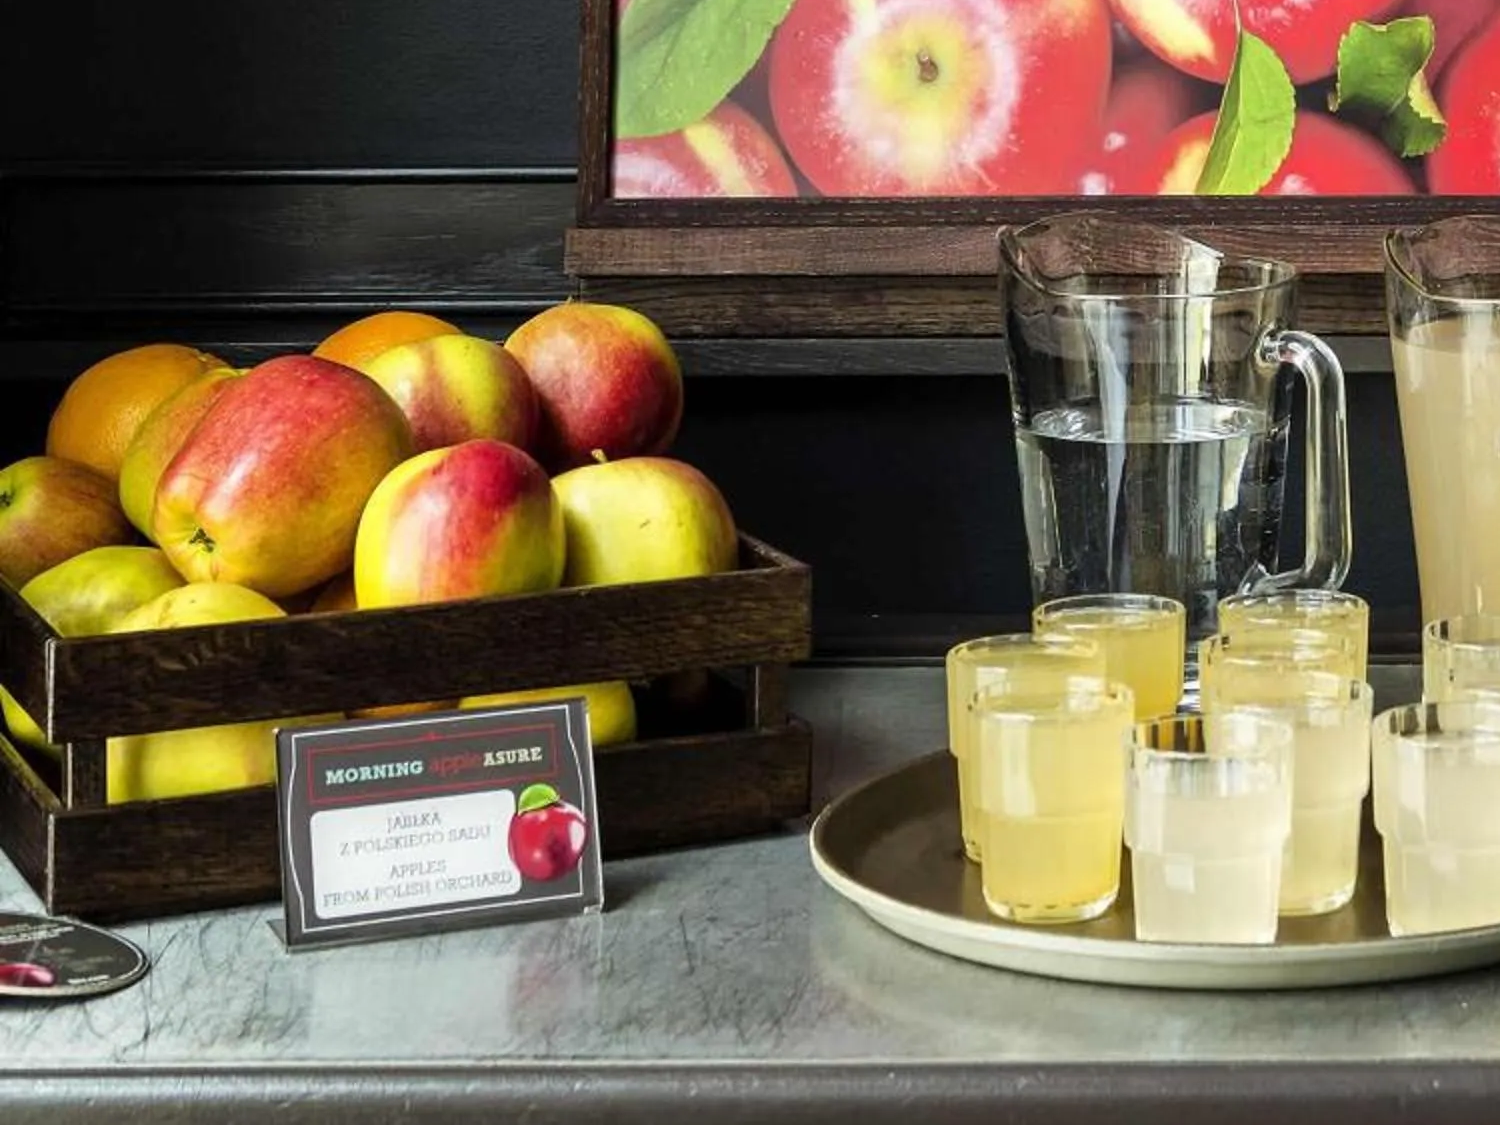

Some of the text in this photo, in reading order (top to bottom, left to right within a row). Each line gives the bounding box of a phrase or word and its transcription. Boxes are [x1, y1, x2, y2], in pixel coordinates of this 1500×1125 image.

[325, 759, 424, 786] MORNING
[354, 831, 445, 854] POLSKIEGO
[389, 859, 447, 880] APPLES
[323, 870, 513, 908] FROM POLISH ORCHARD
